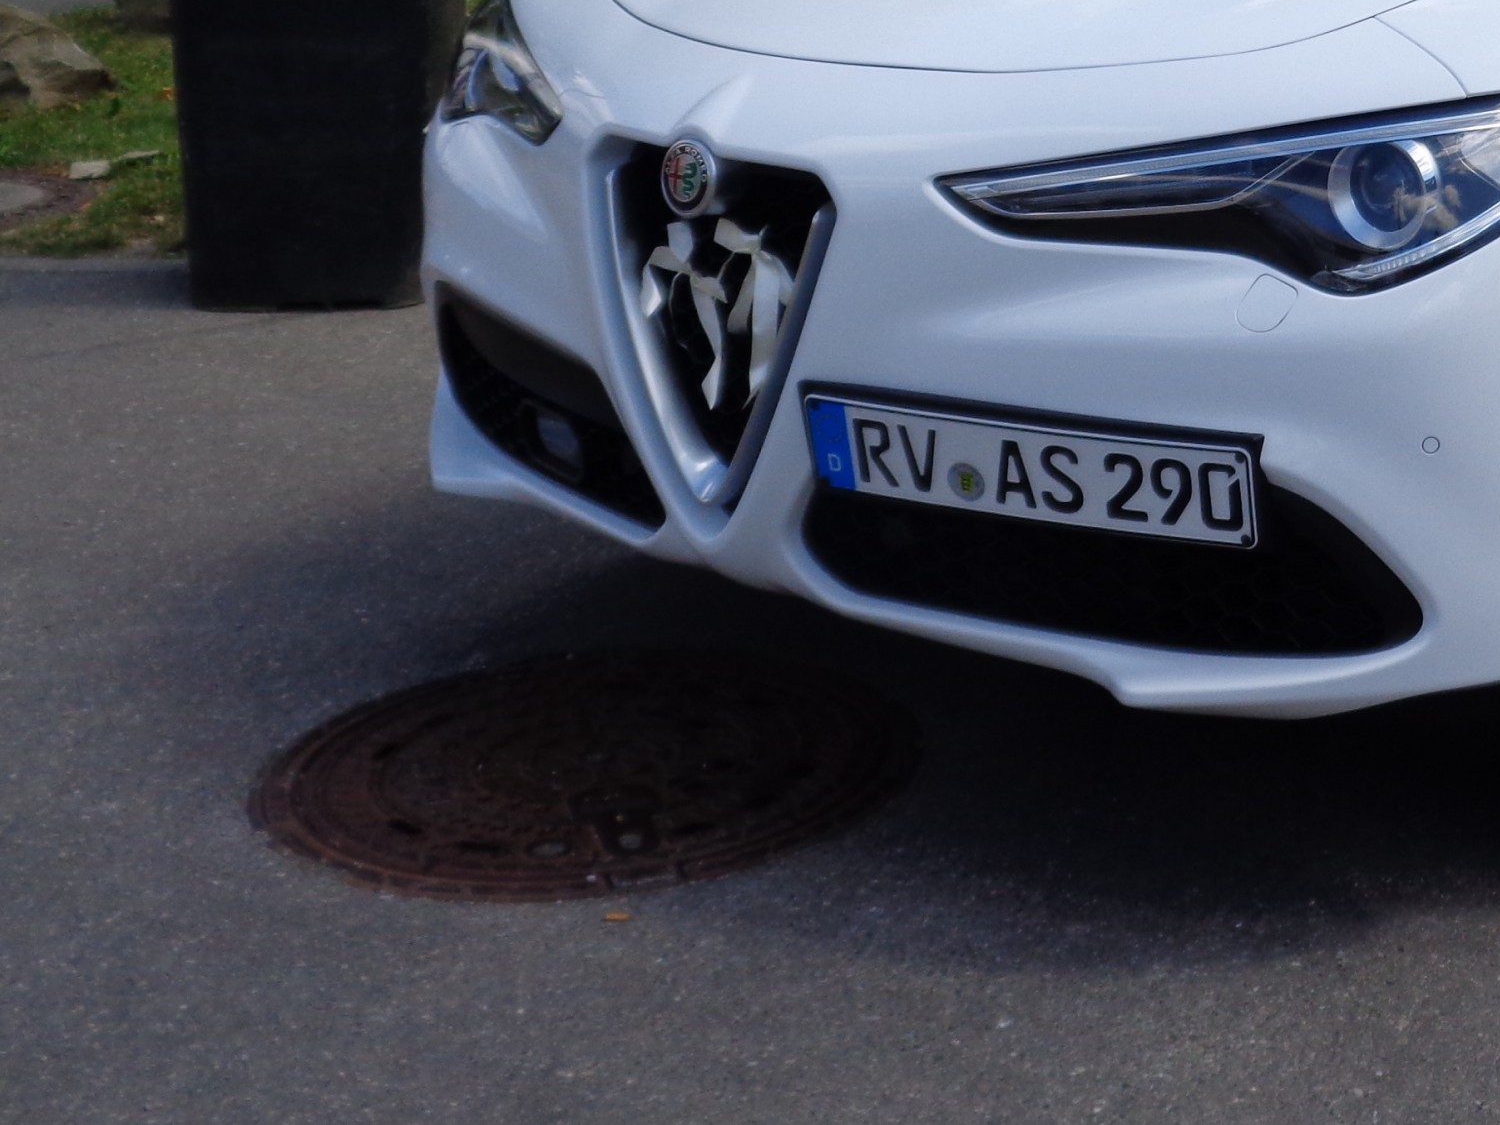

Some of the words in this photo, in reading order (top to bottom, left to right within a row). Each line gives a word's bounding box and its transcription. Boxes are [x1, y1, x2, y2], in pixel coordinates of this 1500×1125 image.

[827, 453, 843, 472] D
[852, 418, 936, 493] RV
[996, 439, 1085, 514] AS
[1102, 452, 1245, 532] 290
